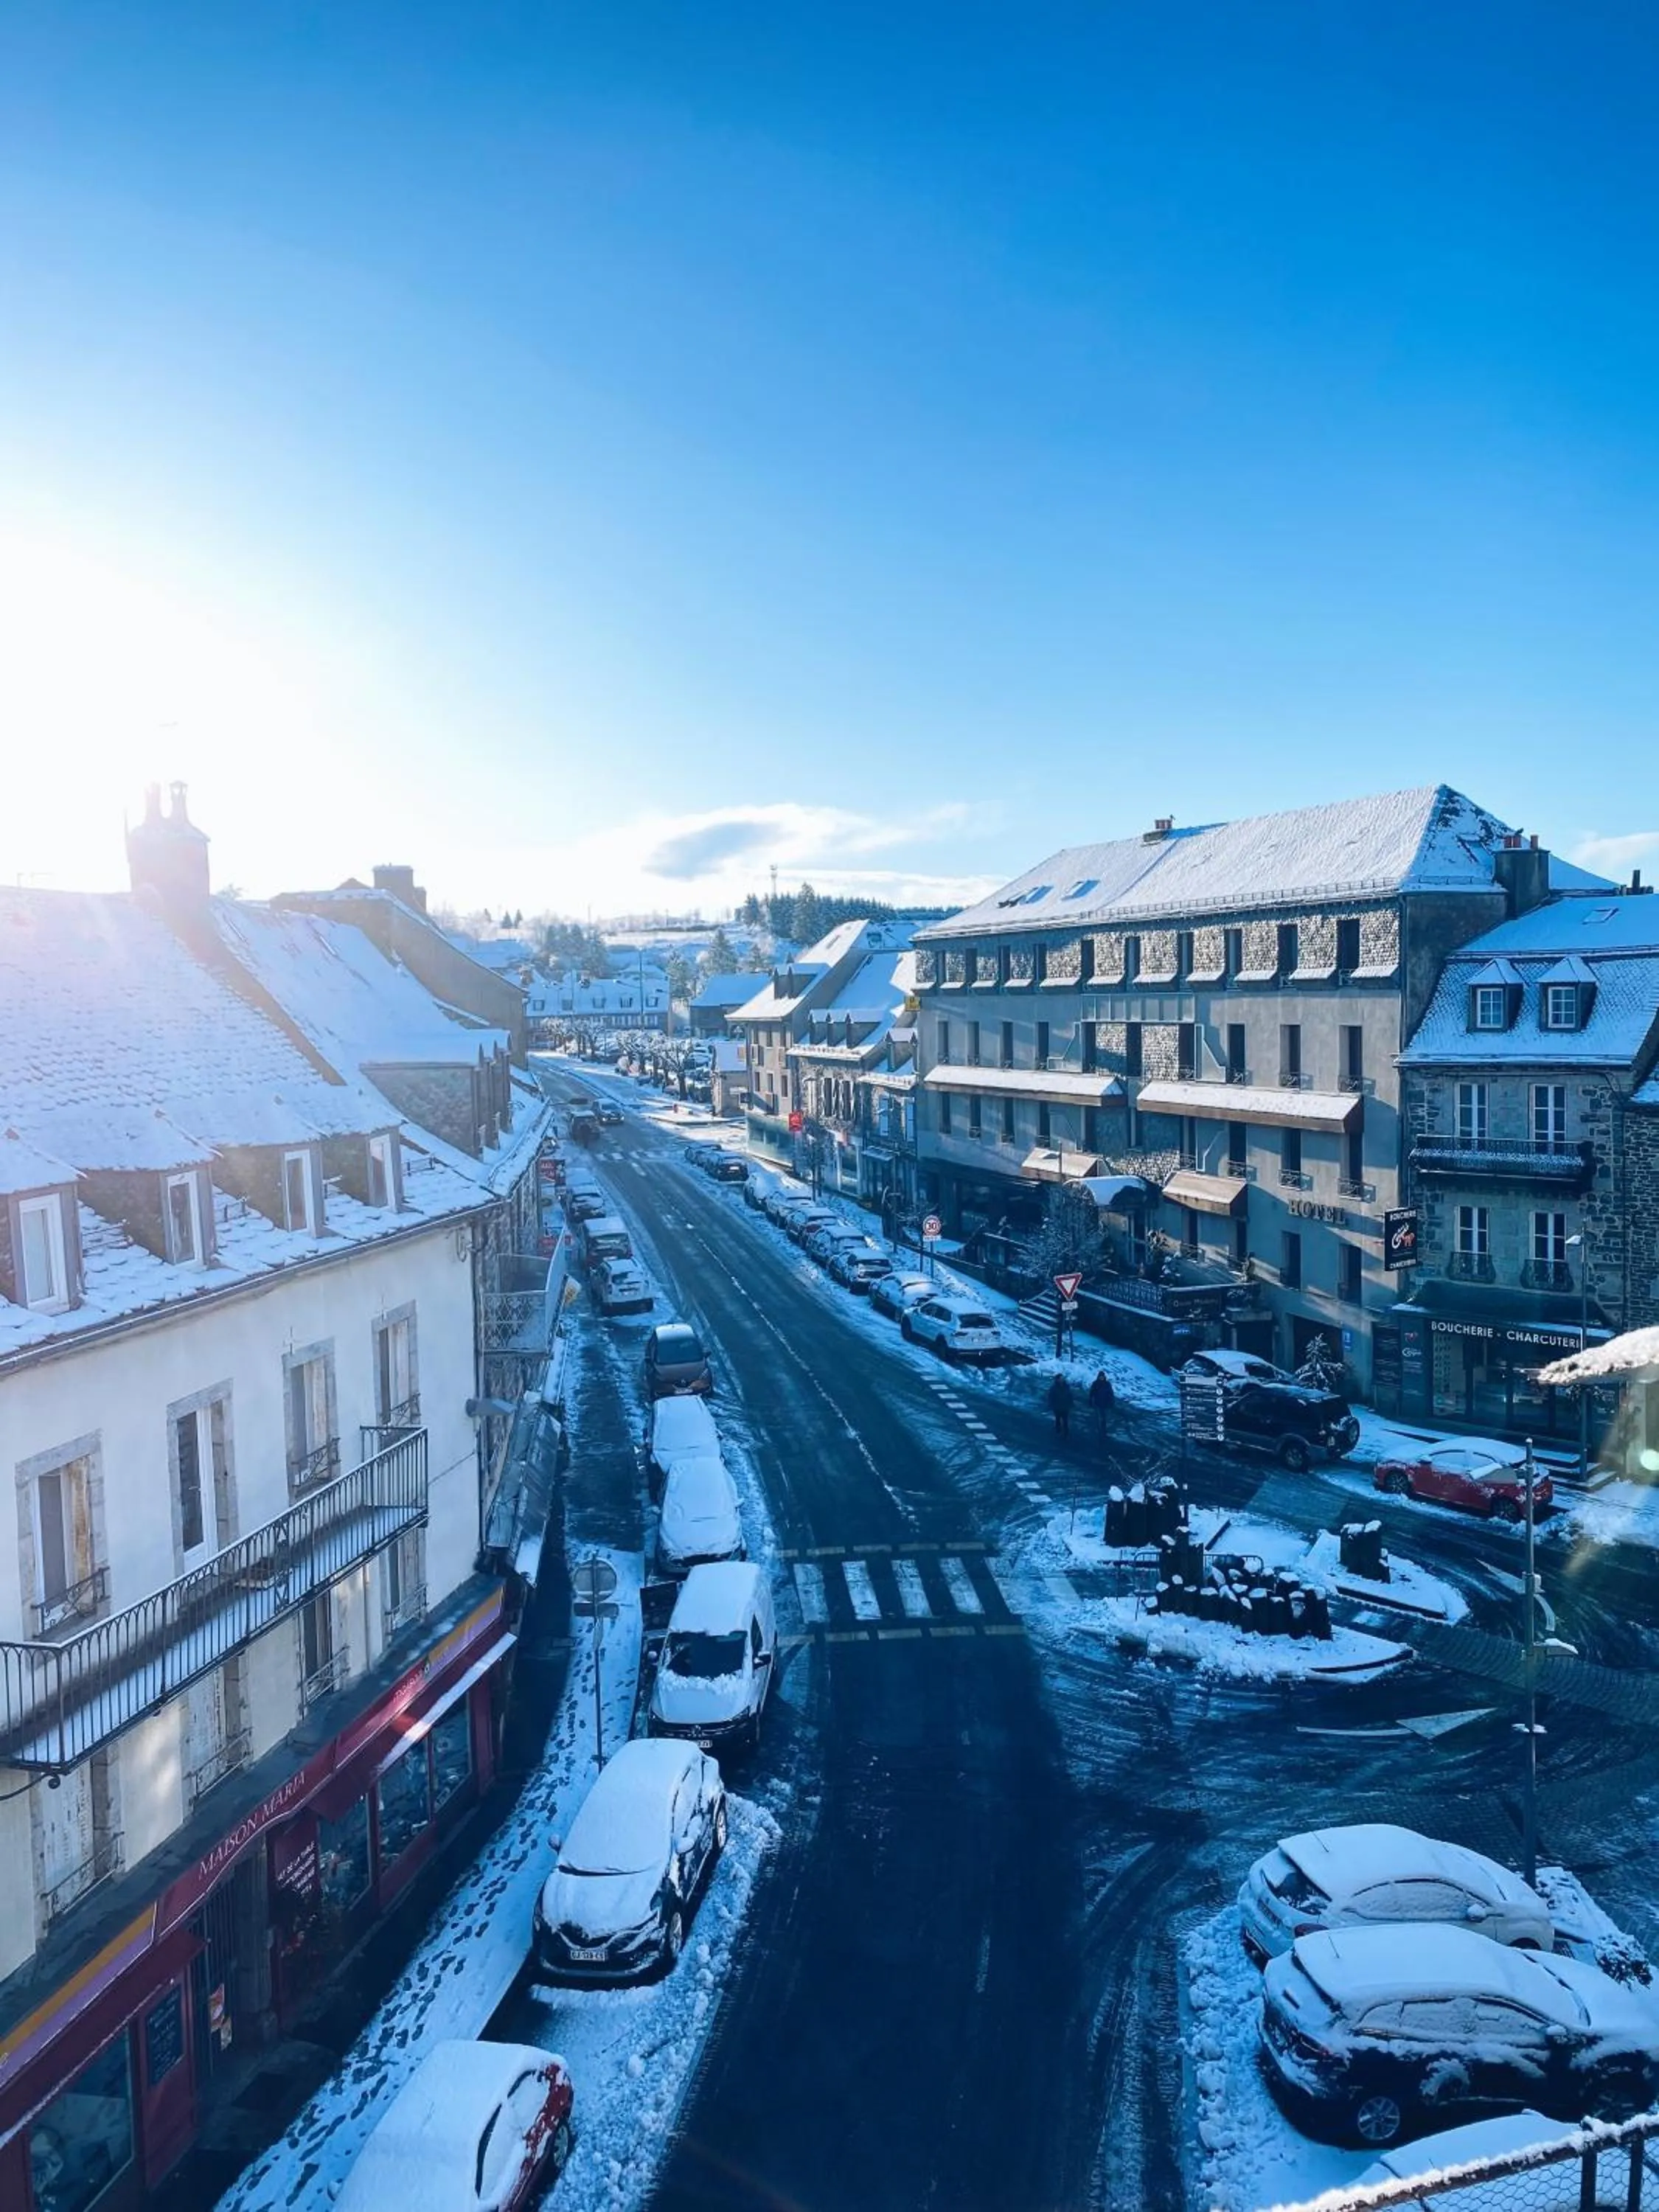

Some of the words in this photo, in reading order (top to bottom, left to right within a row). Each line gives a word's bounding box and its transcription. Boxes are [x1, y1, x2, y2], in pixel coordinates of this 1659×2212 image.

[1289, 1200, 1346, 1225] HOTEL
[927, 1222, 937, 1231] 30
[1430, 1321, 1493, 1338] BOUCHERIE
[1506, 1330, 1580, 1349] CHARCUTERI
[198, 1814, 259, 1881] MAISON
[262, 1770, 305, 1823] MARIA
